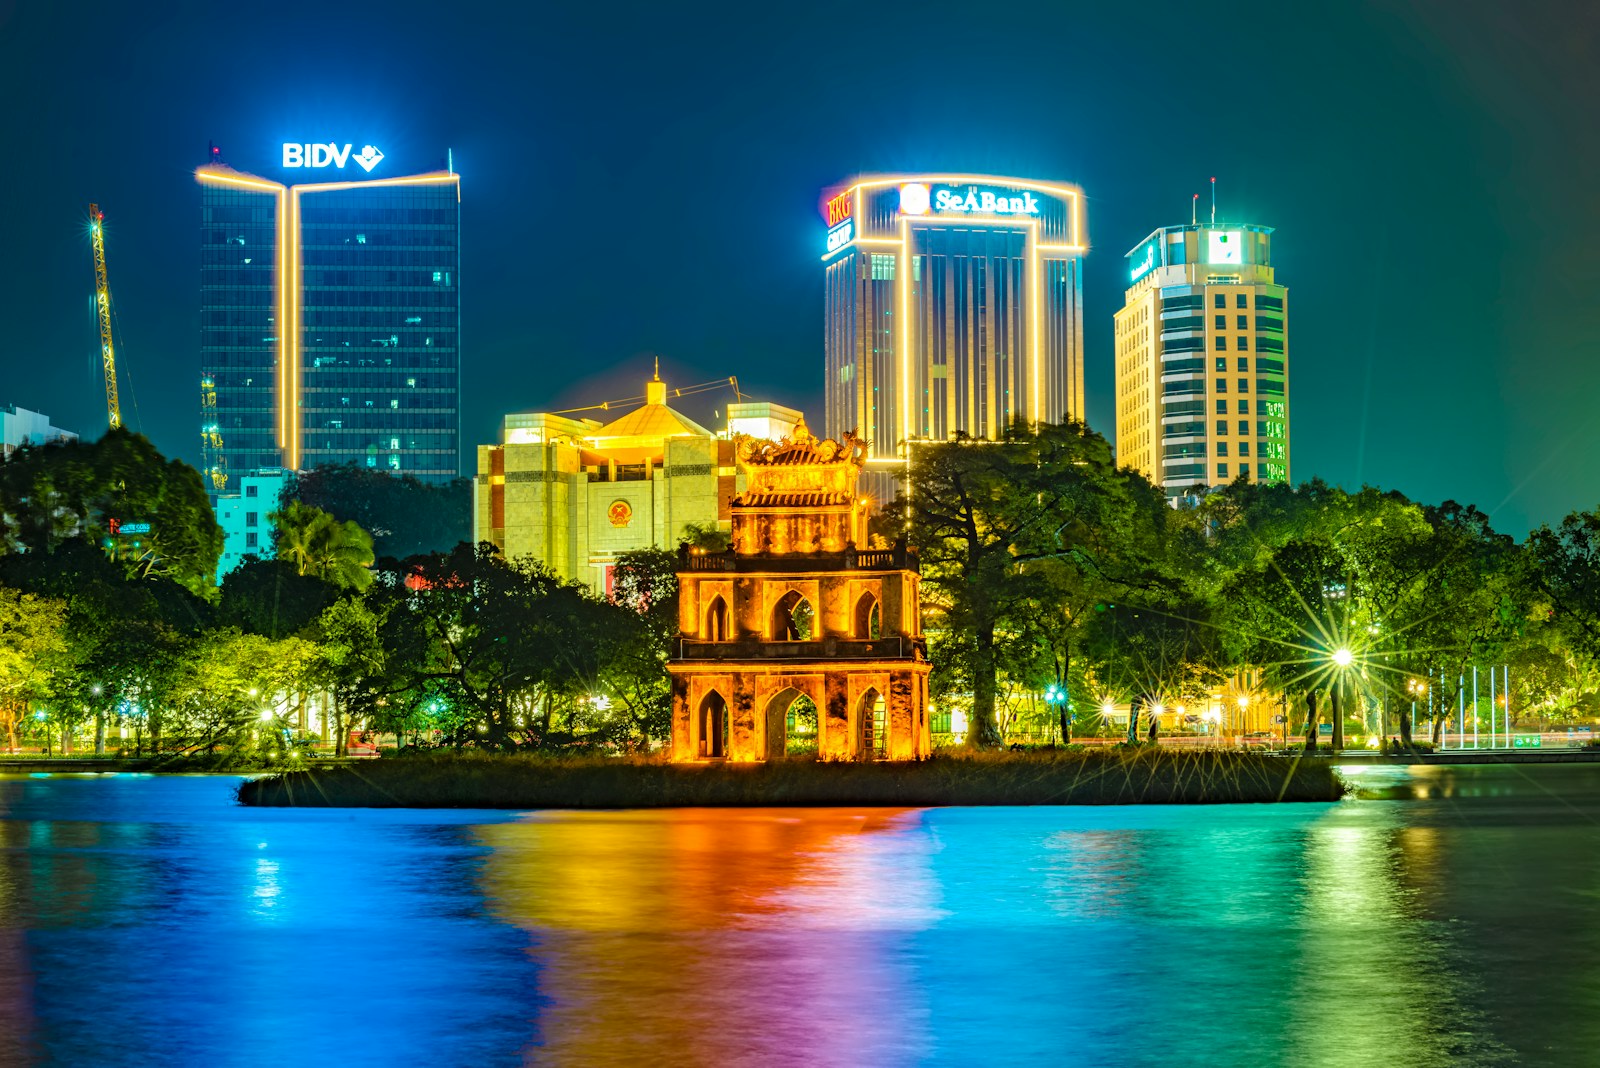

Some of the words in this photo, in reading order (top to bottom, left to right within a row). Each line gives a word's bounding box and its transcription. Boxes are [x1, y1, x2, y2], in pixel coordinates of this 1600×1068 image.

[282, 142, 353, 168] BIDV
[827, 192, 851, 227] BRG
[935, 189, 1039, 214] SeABank
